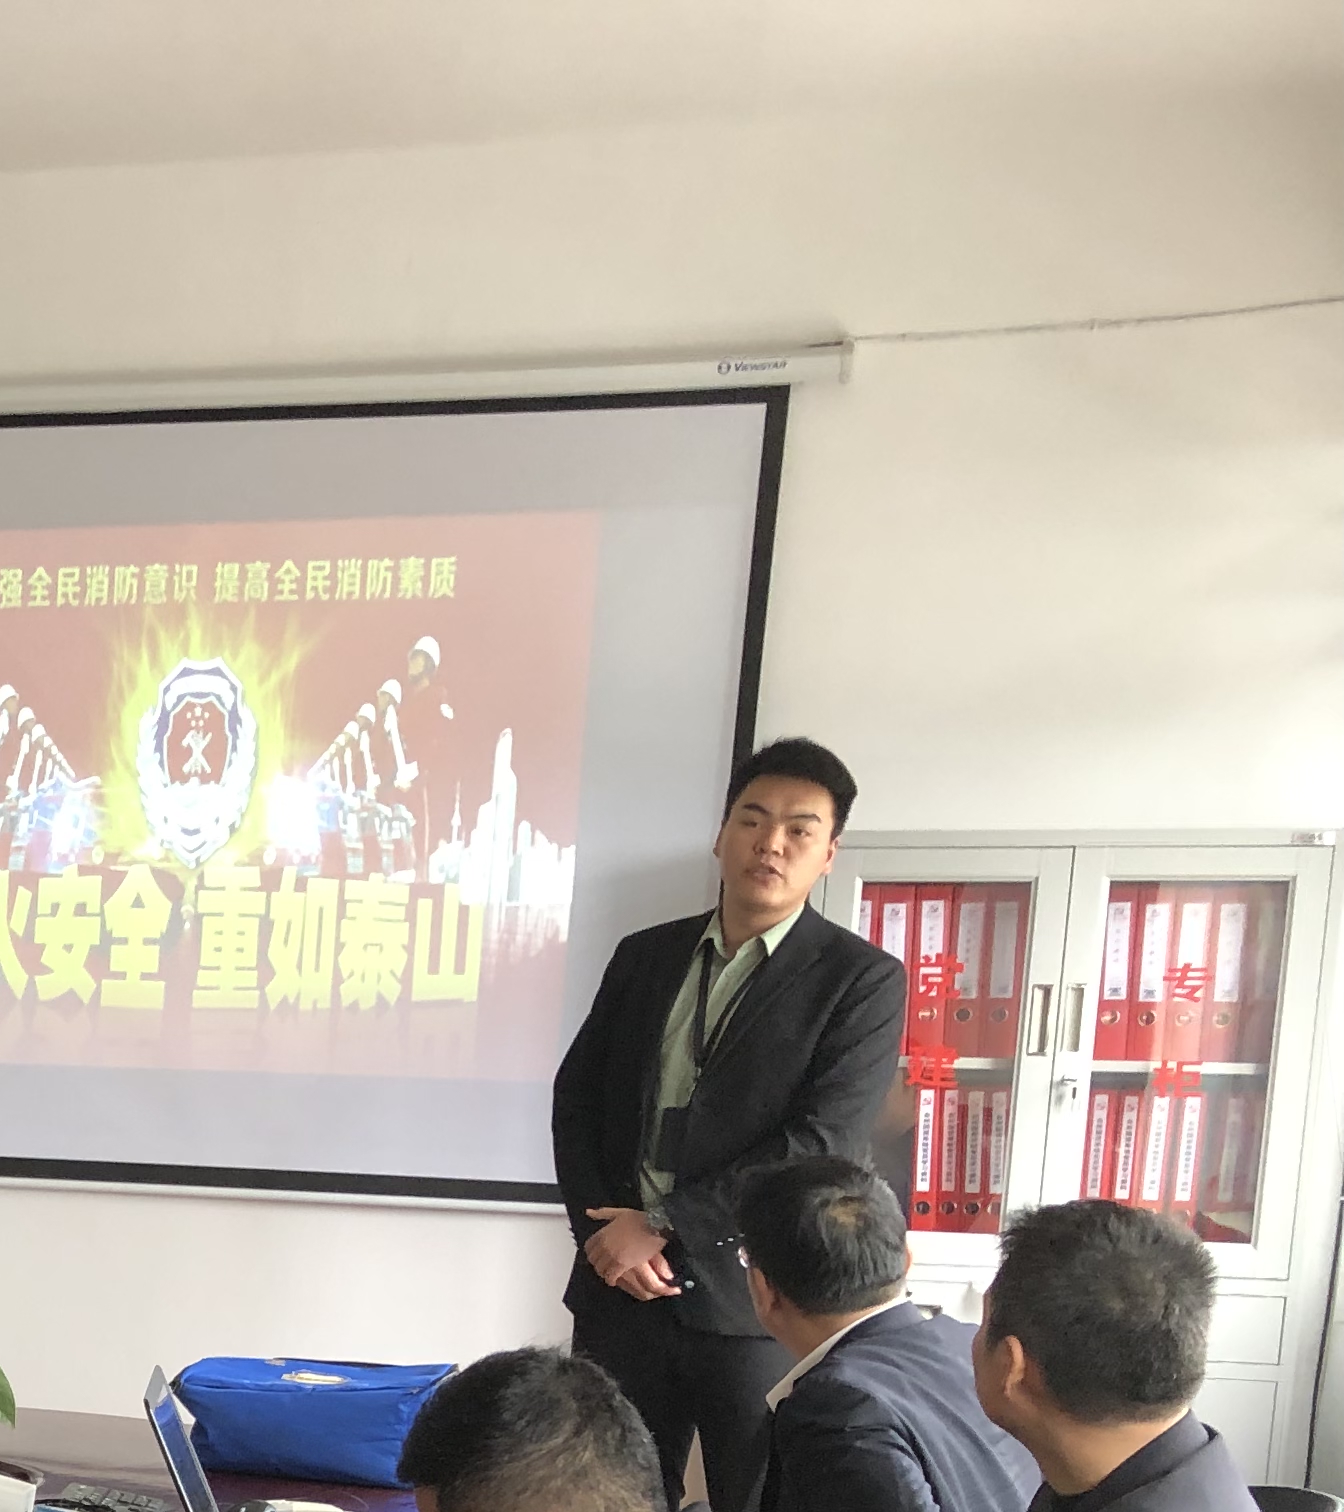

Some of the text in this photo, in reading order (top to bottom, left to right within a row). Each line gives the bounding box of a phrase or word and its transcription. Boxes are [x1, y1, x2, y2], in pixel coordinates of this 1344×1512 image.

[215, 555, 458, 602] 提高全民消防素质
[192, 865, 484, 1011] 重如泰山
[907, 953, 964, 1089] 党建
[1152, 962, 1211, 1098] 专柜
